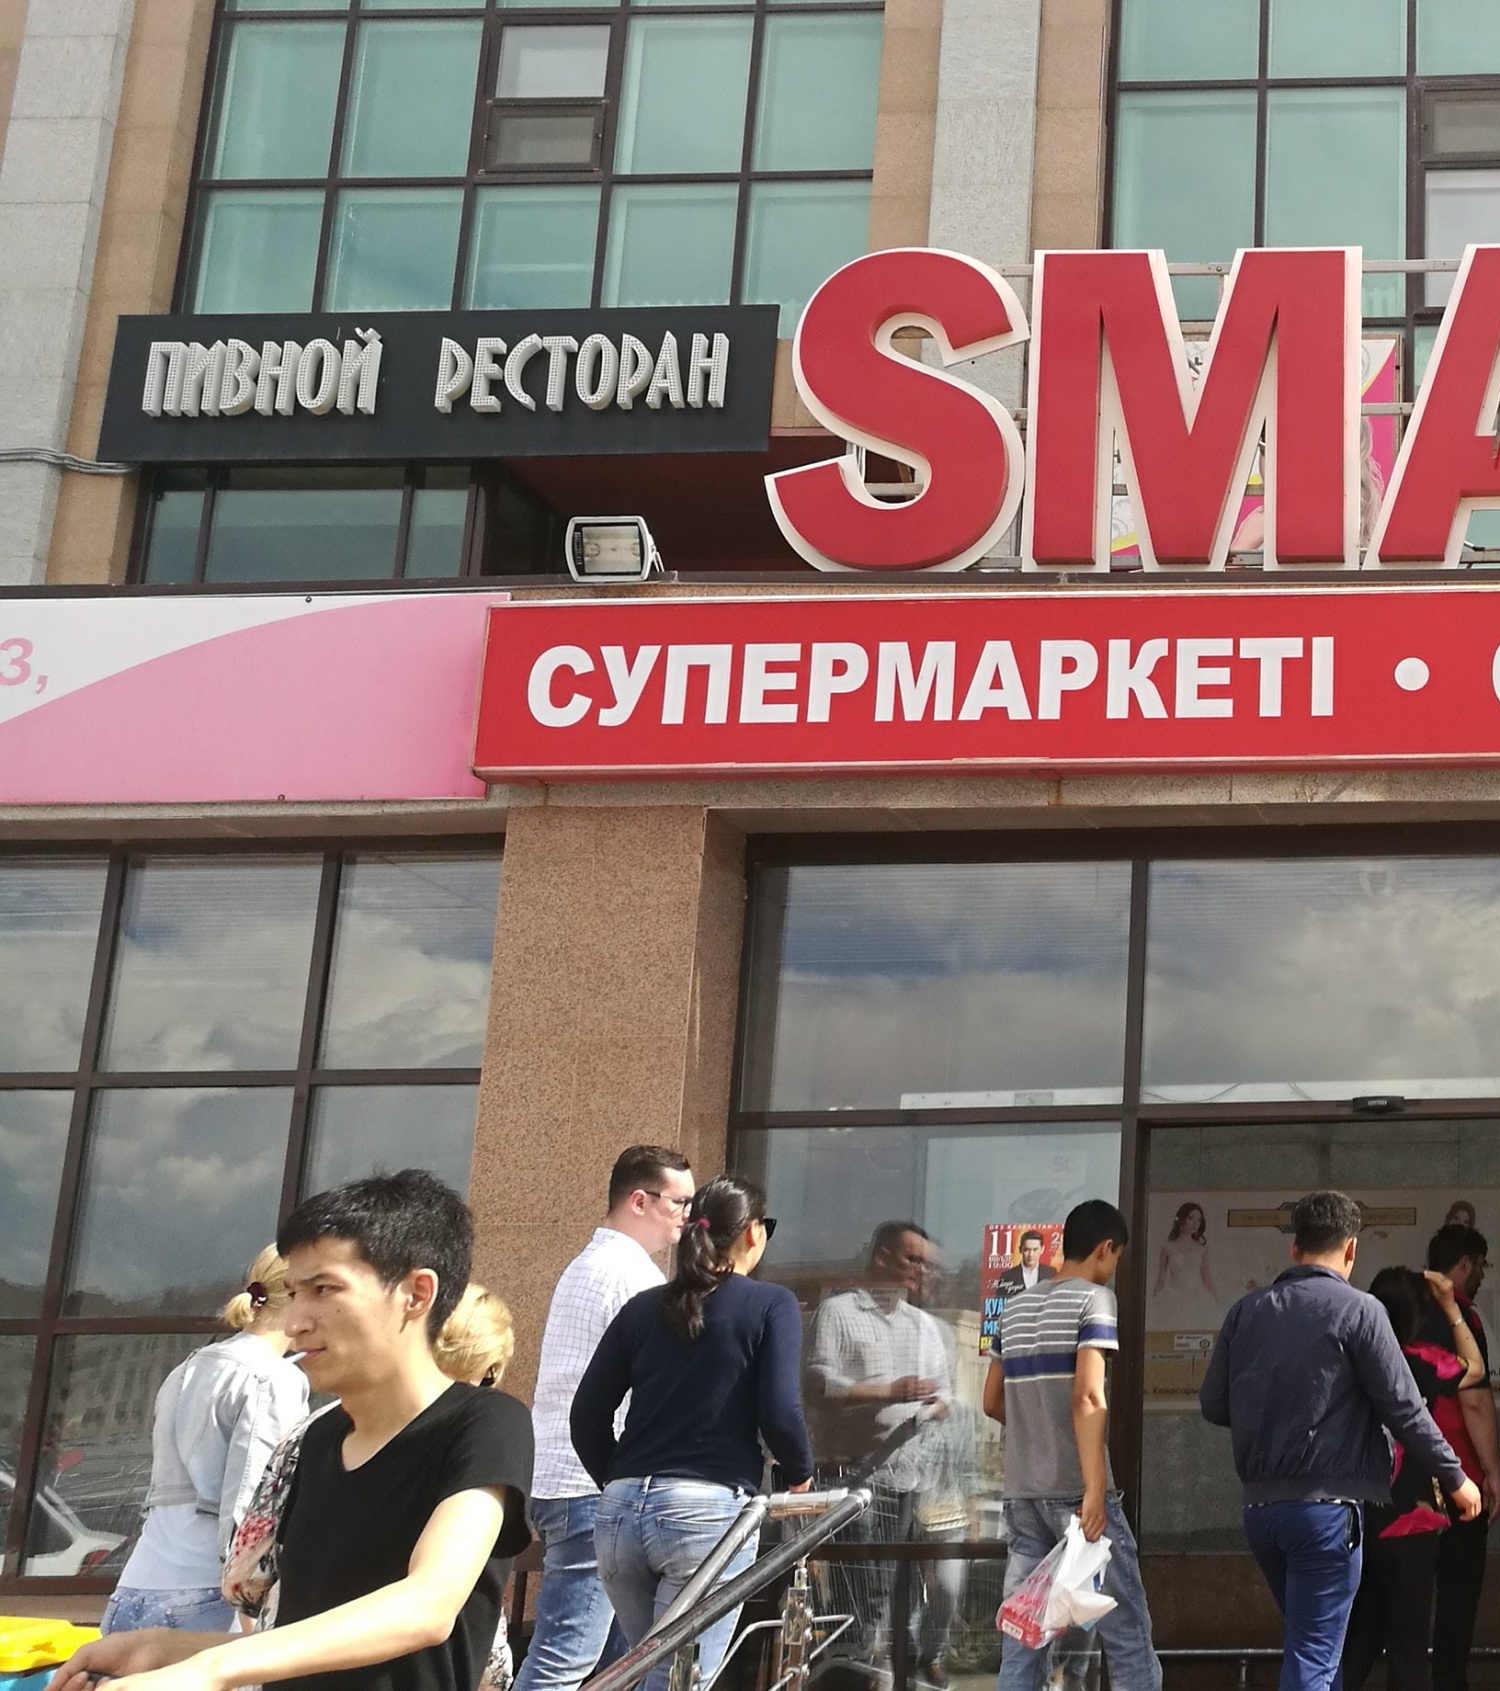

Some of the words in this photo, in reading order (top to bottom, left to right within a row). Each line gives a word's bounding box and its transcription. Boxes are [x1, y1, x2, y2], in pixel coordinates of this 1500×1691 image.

[142, 327, 383, 417] ПИВНОЙ
[434, 330, 730, 413] РЕСТОРАН
[528, 636, 1335, 728] СУПЕРМАРКЕТІ
[990, 1230, 1013, 1256] 11
